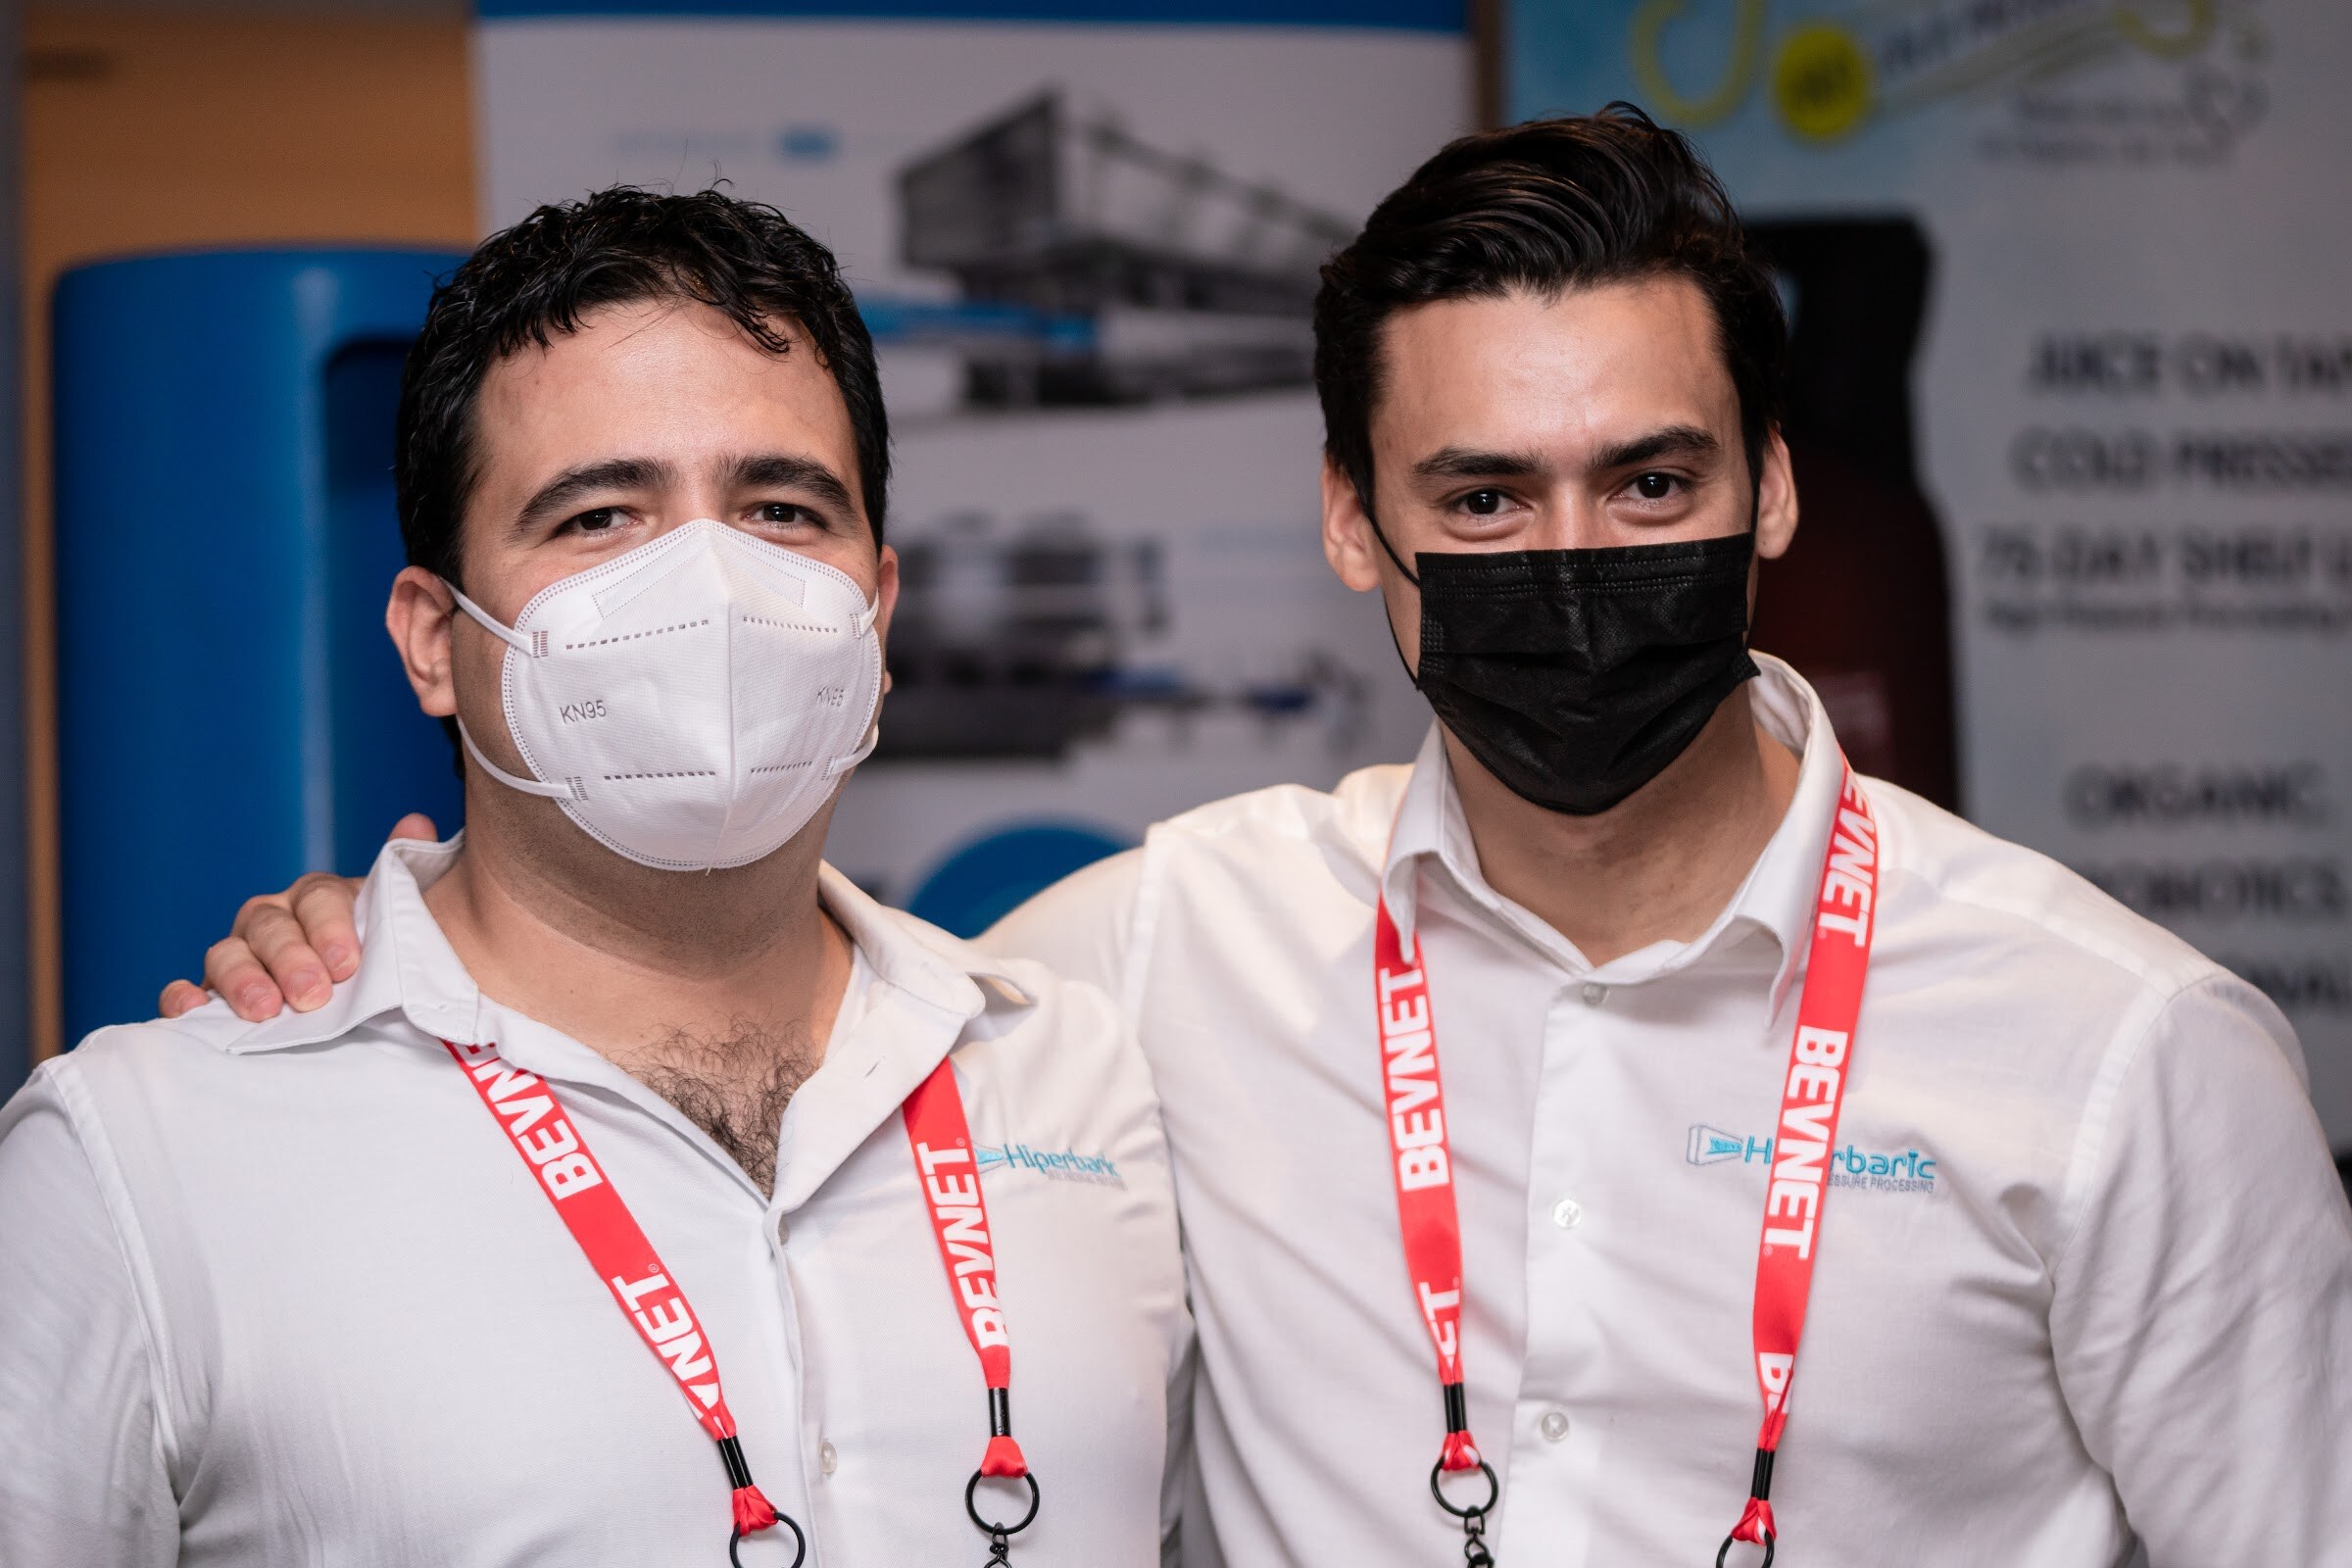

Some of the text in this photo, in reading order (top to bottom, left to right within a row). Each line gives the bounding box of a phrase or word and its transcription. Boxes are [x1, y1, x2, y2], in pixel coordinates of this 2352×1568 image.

[2176, 335, 2259, 391] ON
[559, 699, 607, 724] KN95
[1818, 770, 1877, 948] EVNET
[1379, 966, 1450, 1192] BEVNET
[1744, 1136, 1936, 1180] Hrbaric
[1765, 1025, 1849, 1260] BEVNET
[1827, 1173, 1935, 1194] ESSURE PROCESSING
[916, 1142, 1009, 1349] BEVNET
